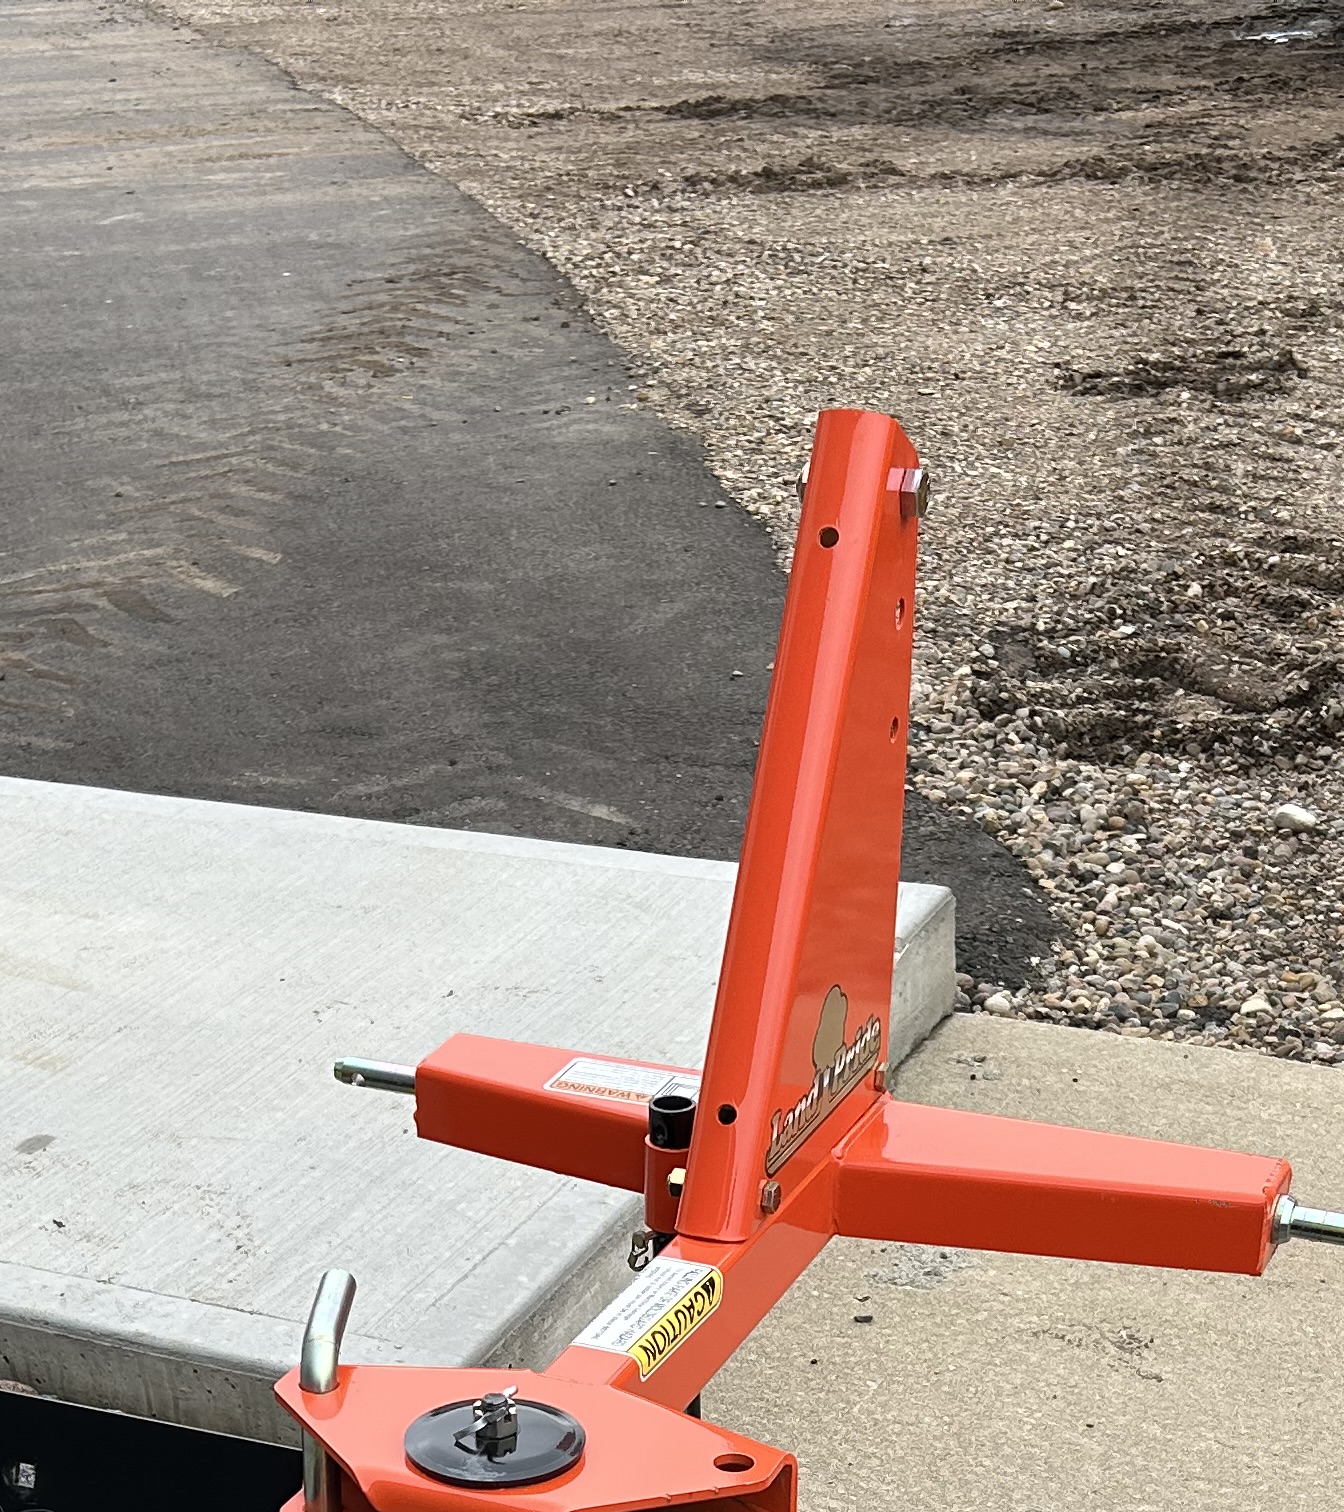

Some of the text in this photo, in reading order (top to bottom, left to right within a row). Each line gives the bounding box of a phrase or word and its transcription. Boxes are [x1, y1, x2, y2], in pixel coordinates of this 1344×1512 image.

[769, 1014, 881, 1157] Land Pride
[638, 1291, 706, 1367] CAUTION
